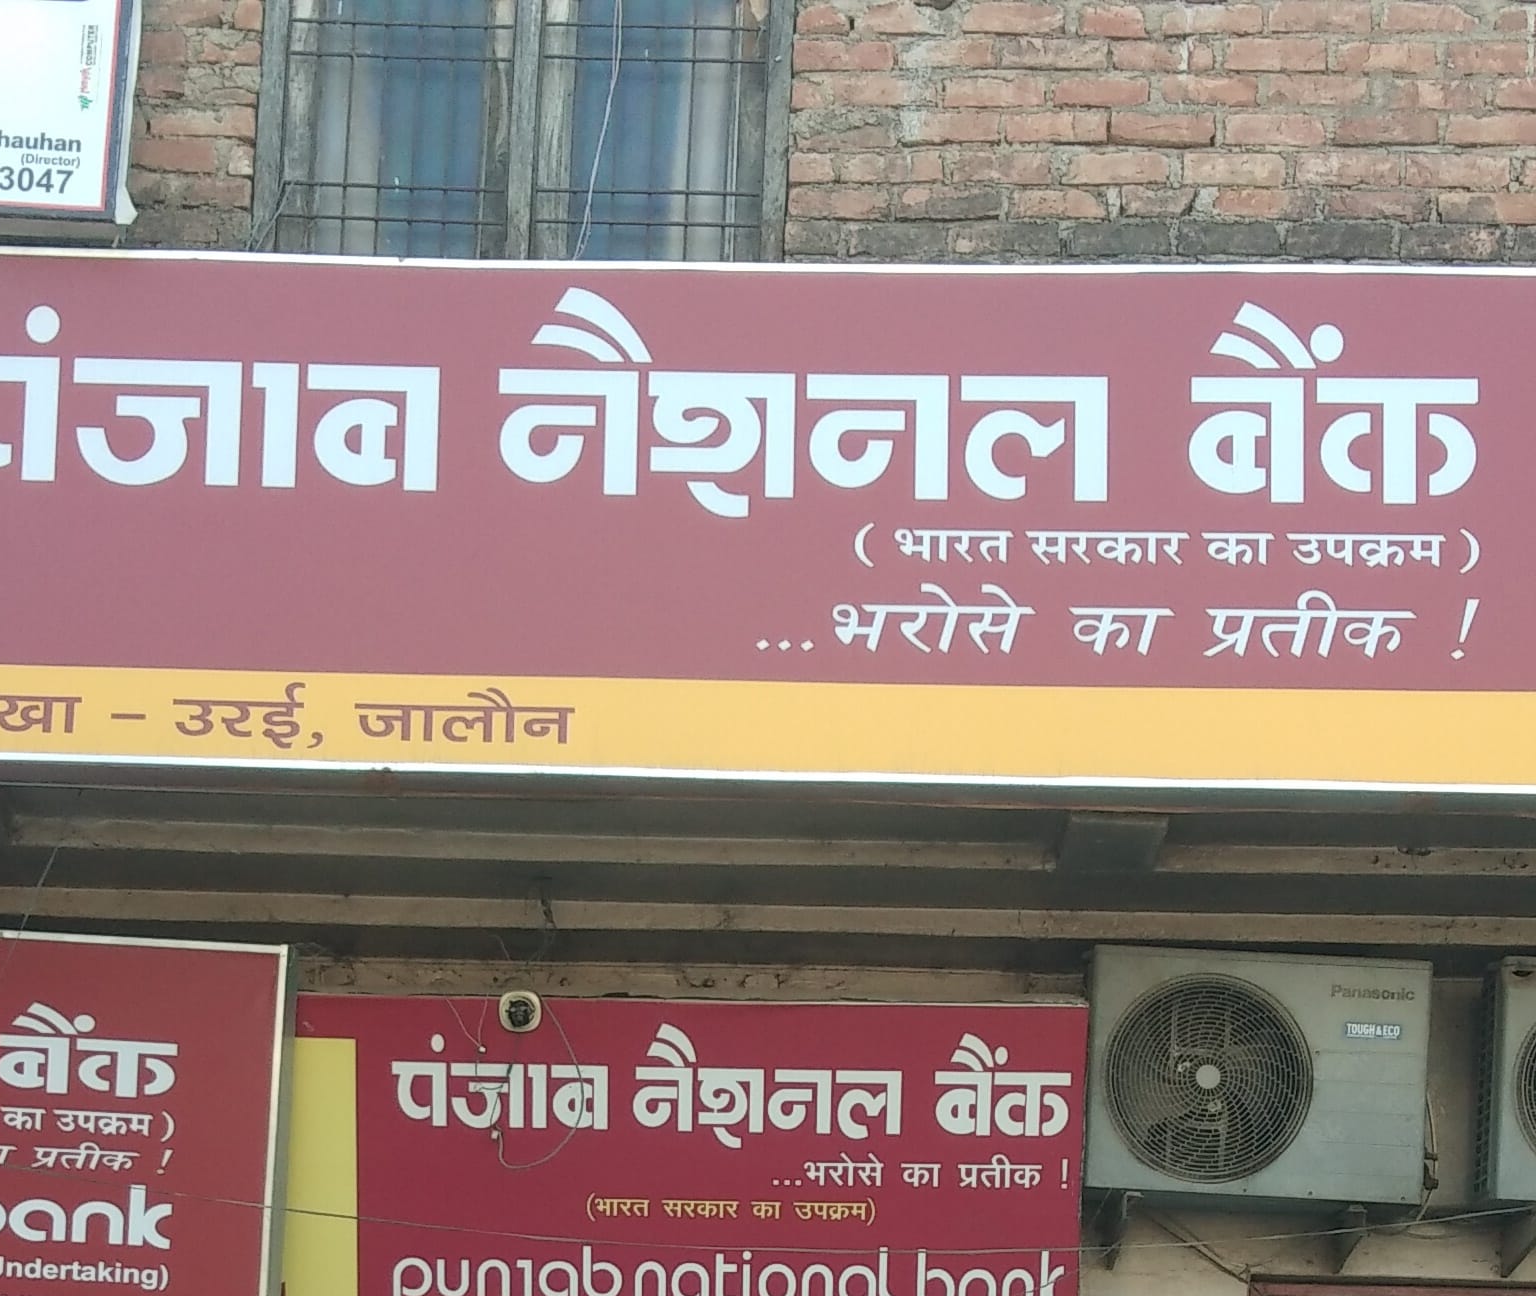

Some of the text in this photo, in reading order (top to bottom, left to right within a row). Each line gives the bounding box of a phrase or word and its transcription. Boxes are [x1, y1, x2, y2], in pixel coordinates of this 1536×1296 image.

[21, 153, 81, 168] (Director)
[498, 286, 1110, 519] नैशनल
[1188, 301, 1479, 505] बैंक
[1025, 529, 1190, 566] सरकार
[1201, 530, 1274, 566] का
[1285, 531, 1447, 569] उपक्रम
[1069, 590, 1417, 659] का प्रतीक
[173, 682, 325, 750] उरई,
[354, 687, 575, 745] जालौन
[1330, 984, 1415, 1001] Panasonic
[391, 1023, 1072, 1148] पंजाब नैशनल बैंक
[1, 1107, 44, 1133] का
[32, 1142, 141, 1173] प्रतीक
[901, 1154, 1043, 1189] का प्रतीक
[663, 1198, 739, 1219] सरकार
[751, 1200, 781, 1220] का
